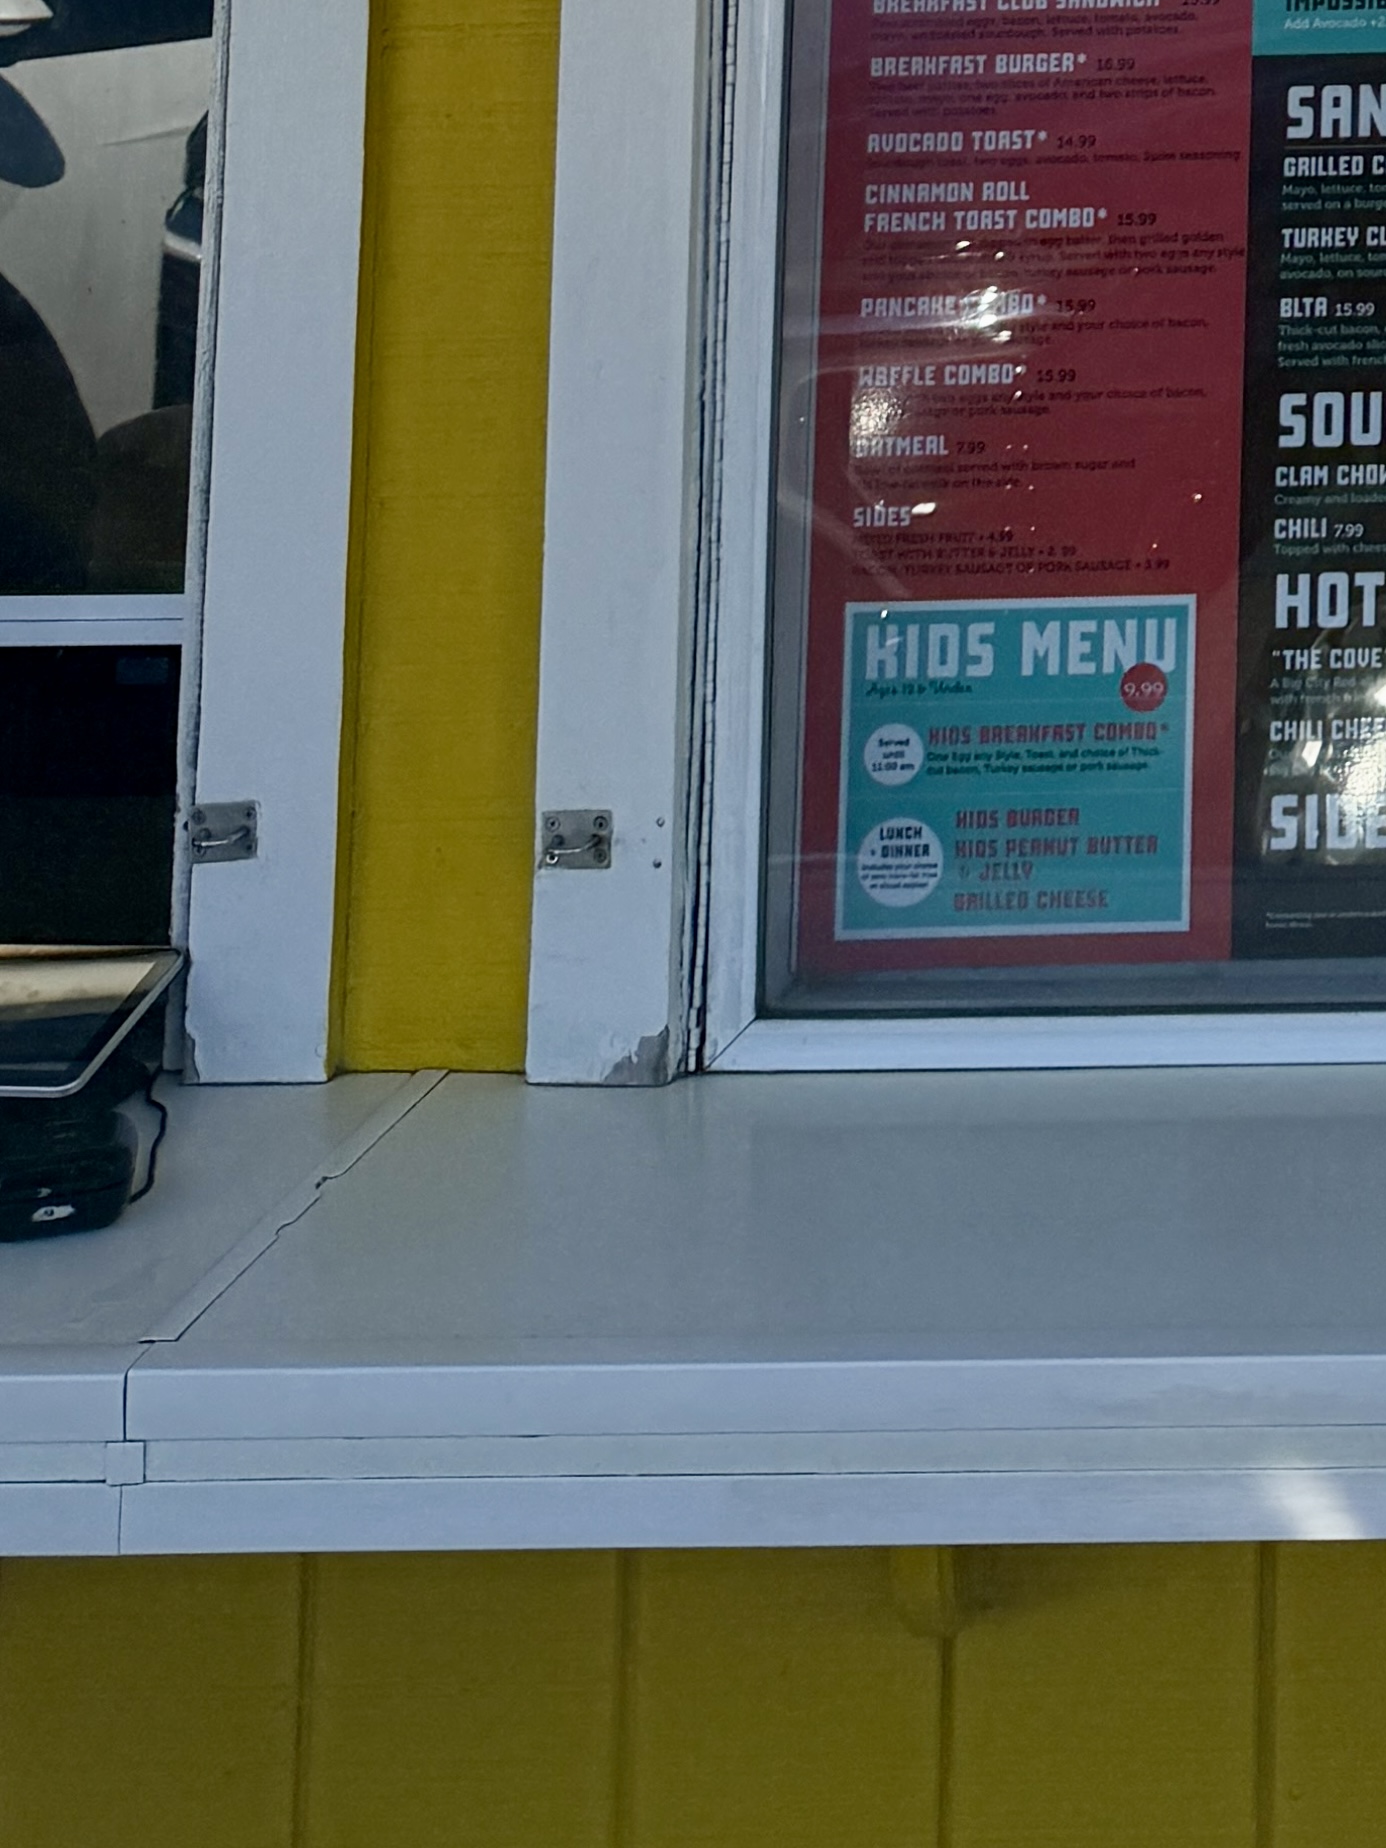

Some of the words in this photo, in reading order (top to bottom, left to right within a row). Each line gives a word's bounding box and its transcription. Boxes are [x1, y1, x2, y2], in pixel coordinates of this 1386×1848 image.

[867, 132, 963, 153] AVOCADO
[1057, 135, 1096, 149] 14.99
[1283, 156, 1364, 177] GRILLED
[866, 183, 973, 204] CINNAMON
[983, 181, 1029, 201] ROLL
[1281, 227, 1359, 248] TURKEY
[1280, 298, 1327, 317] BLTA
[1334, 303, 1375, 316] 15.99
[1276, 571, 1384, 628] HOT
[865, 622, 996, 679] KIDS
[1021, 617, 1177, 676] MENU
[1123, 682, 1164, 698] 9.99
[879, 827, 922, 840] LUNCH
[880, 844, 930, 858] DINNER
